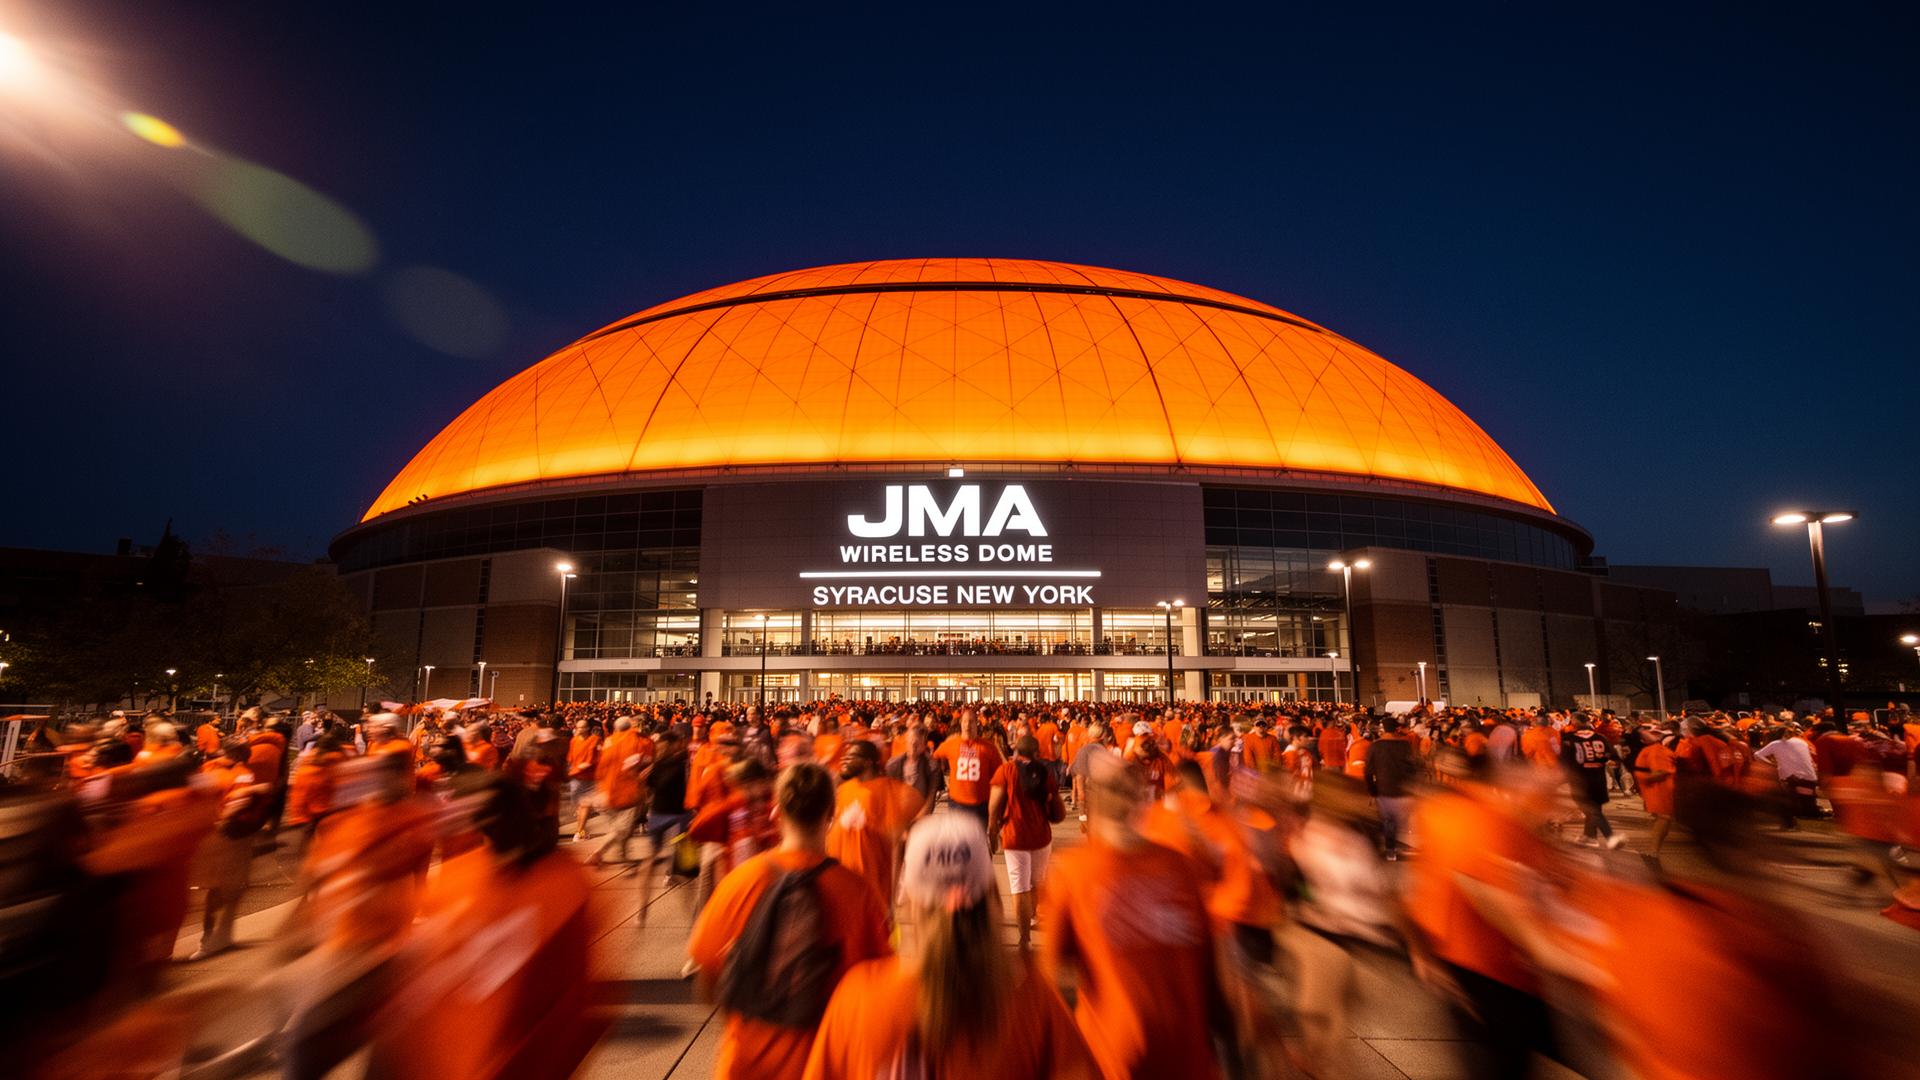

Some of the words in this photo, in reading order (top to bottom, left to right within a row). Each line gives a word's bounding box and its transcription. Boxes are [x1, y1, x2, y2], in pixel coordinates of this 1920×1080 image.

[847, 484, 1048, 537] JMA
[839, 544, 970, 563] WIRELESS
[978, 544, 1053, 562] DOME
[812, 585, 949, 605] SYRACUSE
[957, 585, 1015, 604] NEW
[1022, 585, 1095, 604] YORK
